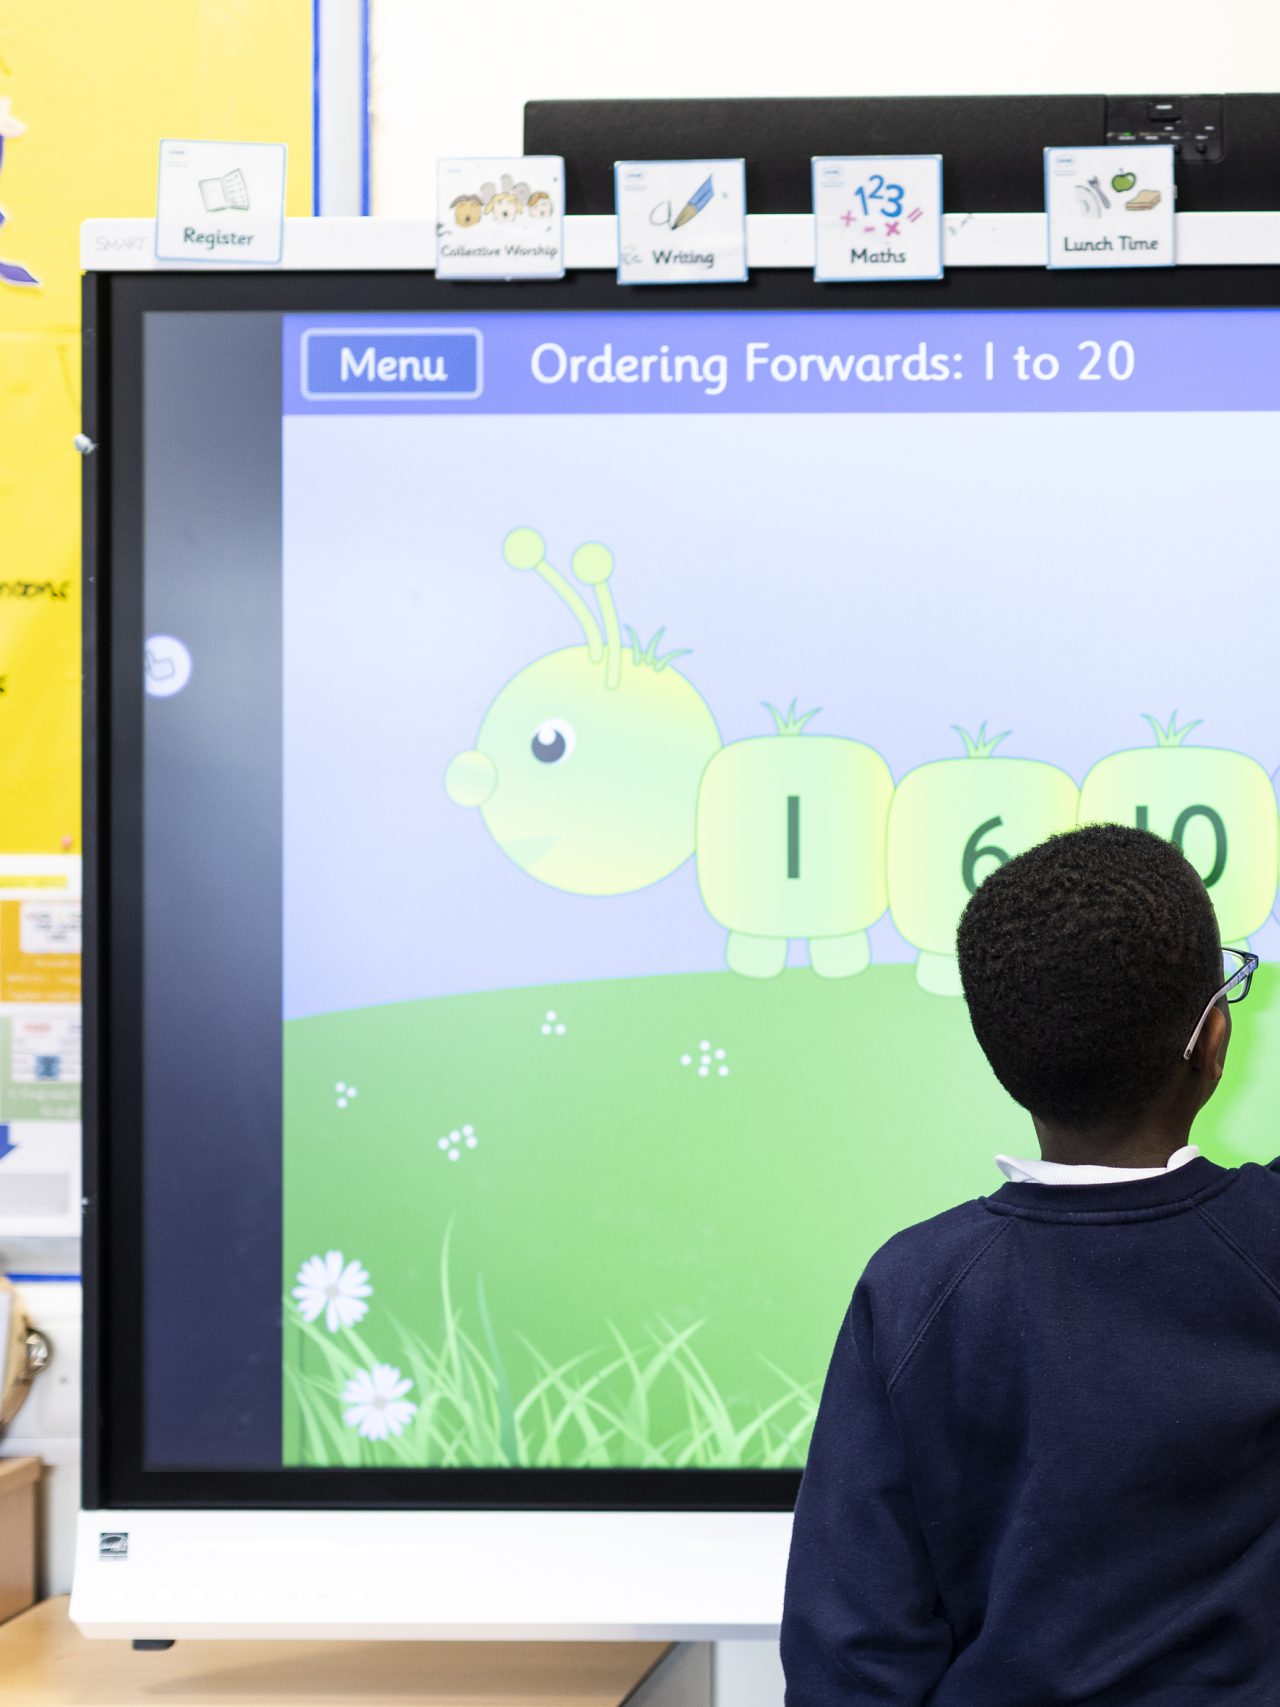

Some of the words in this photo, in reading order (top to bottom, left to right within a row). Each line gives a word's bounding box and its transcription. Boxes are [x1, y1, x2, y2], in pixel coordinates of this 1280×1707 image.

[183, 227, 255, 250] Register
[1064, 236, 1114, 252] Lunch
[1118, 235, 1159, 251] Time
[440, 244, 500, 258] Collective
[504, 244, 558, 260] Worship
[652, 249, 715, 269] Writing
[850, 248, 907, 264] Maths
[341, 346, 448, 382] Menu
[531, 341, 728, 396] Ordering
[746, 341, 963, 382] Forwards:
[1012, 345, 1060, 380] to
[1077, 339, 1134, 381] 20
[962, 815, 1010, 896] 6
